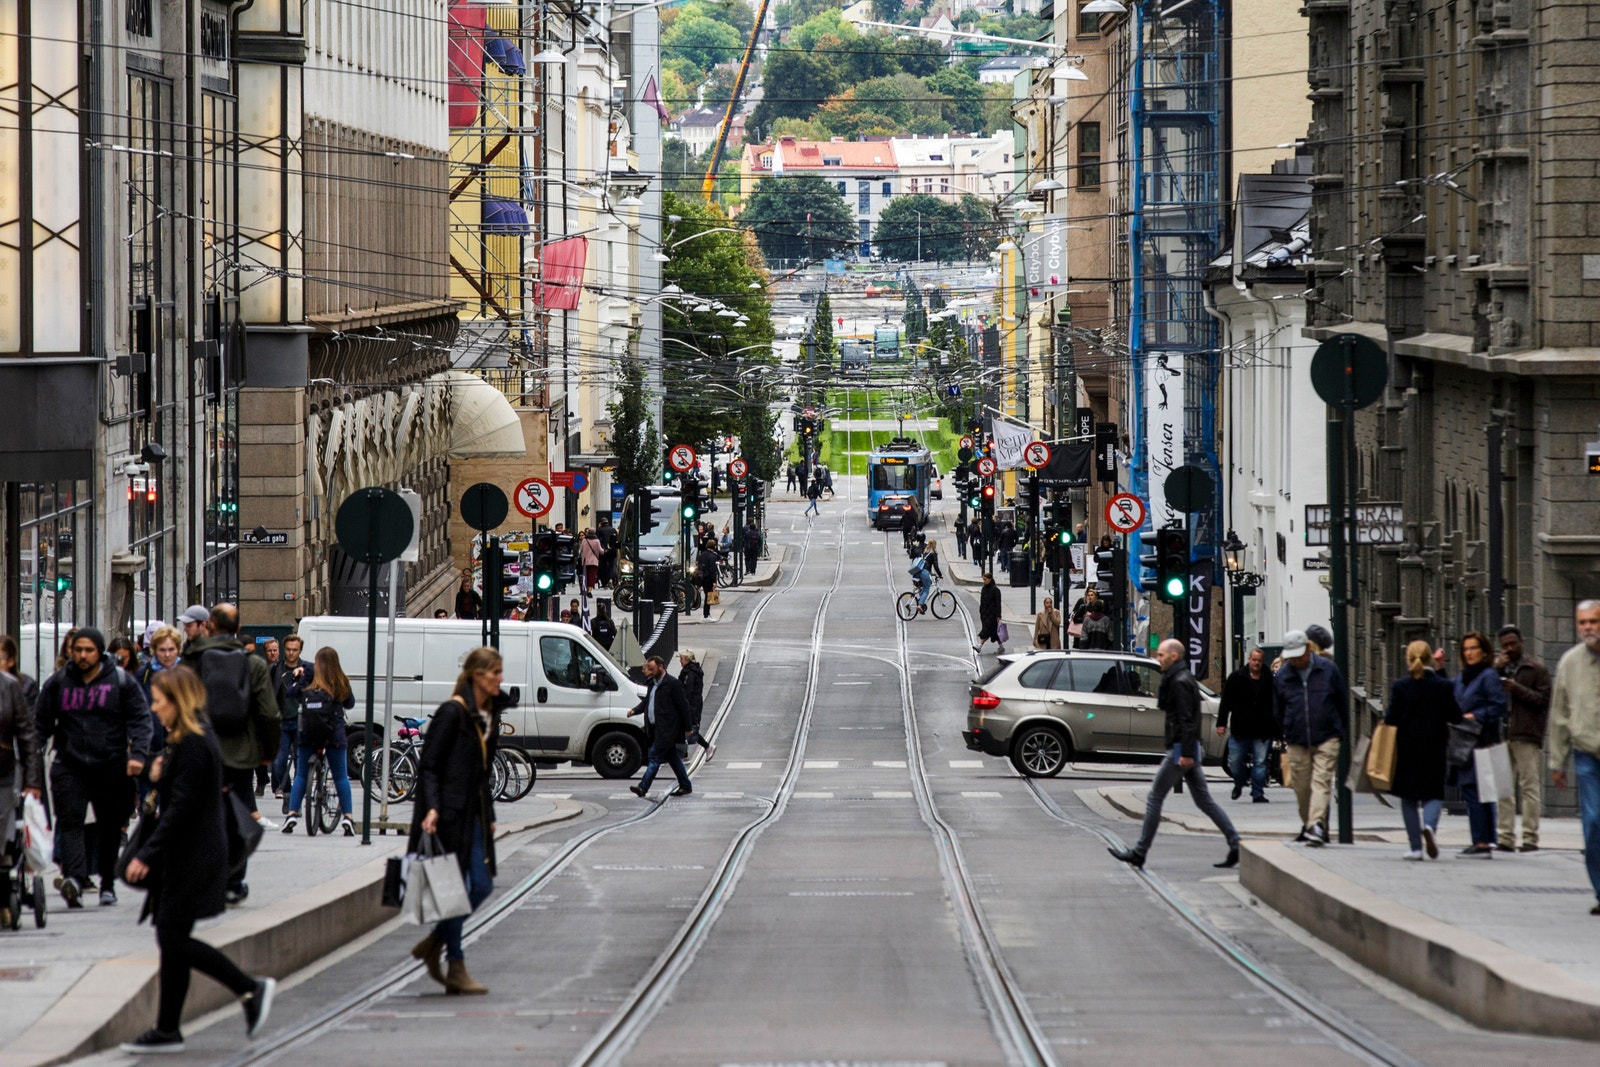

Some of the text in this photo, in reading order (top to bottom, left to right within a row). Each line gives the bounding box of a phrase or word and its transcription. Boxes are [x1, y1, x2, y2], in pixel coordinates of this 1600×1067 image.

[1049, 219, 1061, 270] Citybox
[1081, 415, 1090, 442] HOPE
[1189, 574, 1206, 676] KUNST
